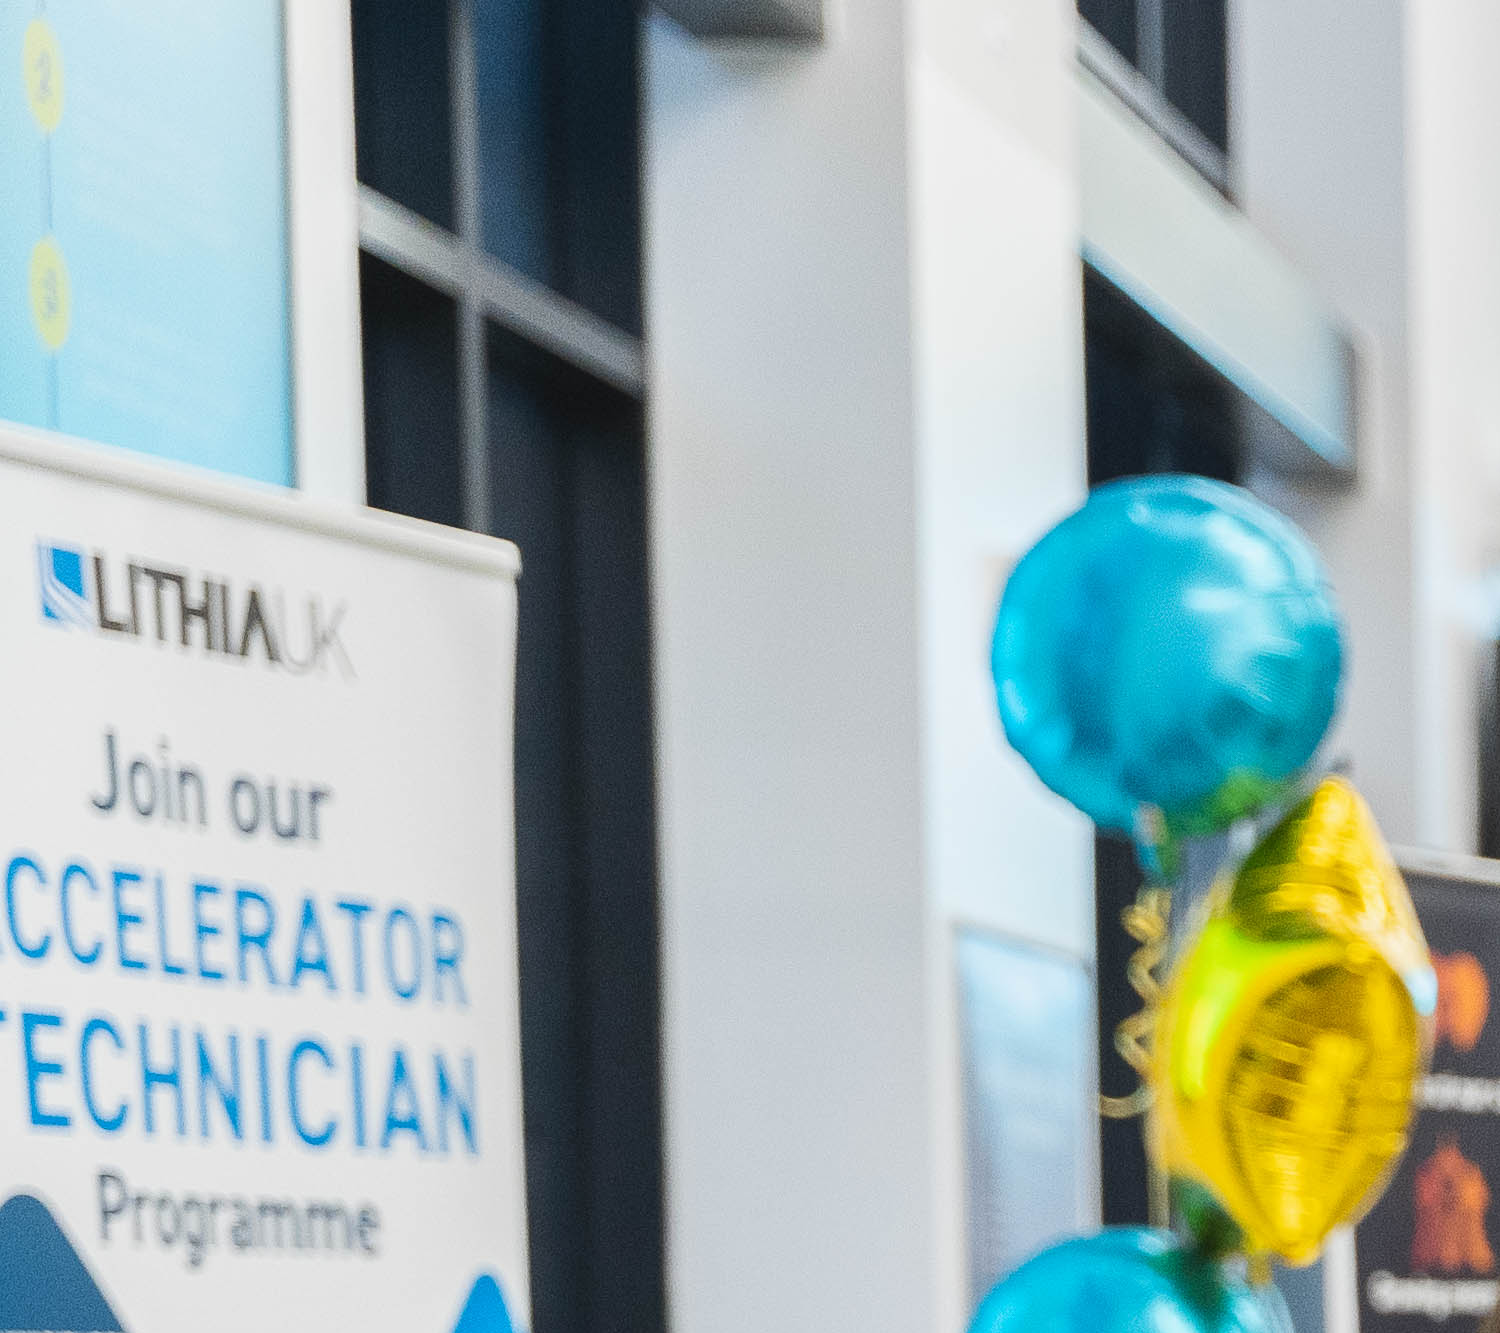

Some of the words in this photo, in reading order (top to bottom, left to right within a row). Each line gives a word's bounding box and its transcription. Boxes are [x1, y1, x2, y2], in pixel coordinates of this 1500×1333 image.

[91, 732, 207, 828] Join
[230, 779, 332, 841] our
[0, 856, 469, 1004] CCELERATOR
[0, 1010, 478, 1155] ECHNICIAN
[97, 1171, 380, 1267] Programme
